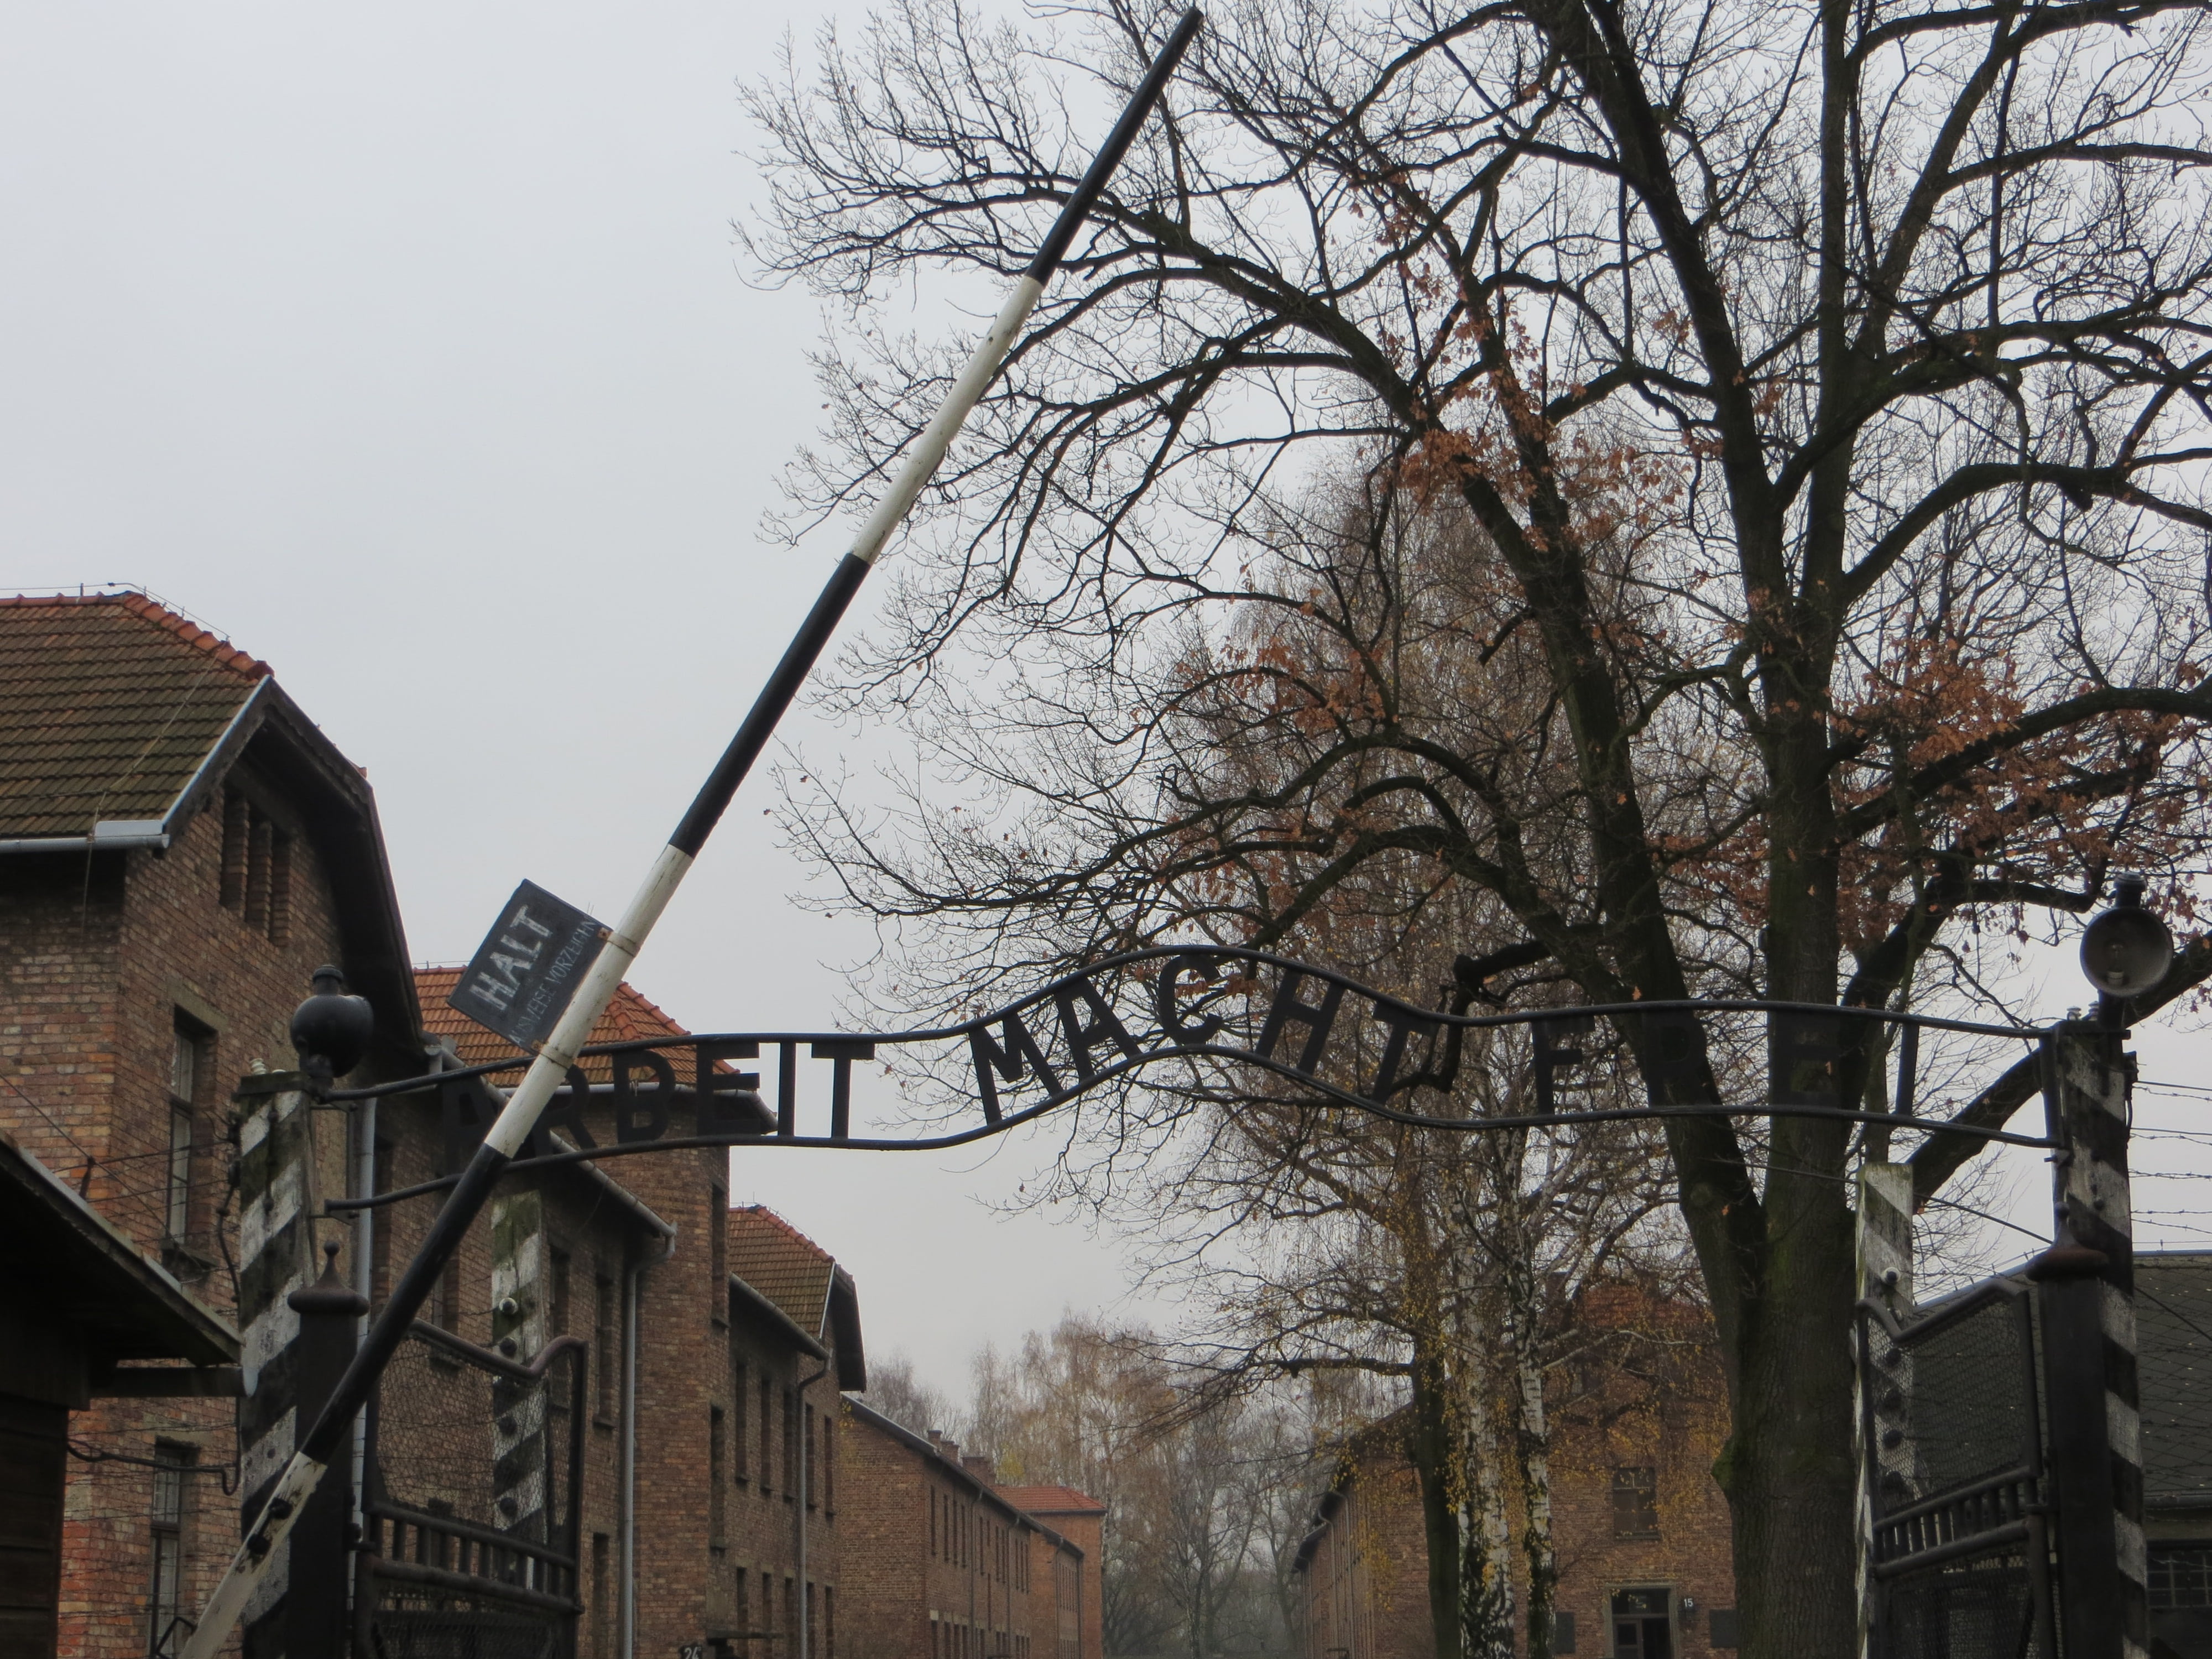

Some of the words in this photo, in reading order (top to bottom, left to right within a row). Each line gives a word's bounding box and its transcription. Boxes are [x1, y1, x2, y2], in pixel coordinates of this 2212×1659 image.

[469, 904, 553, 1011] HALT
[544, 917, 597, 985] VORZEIGEN
[441, 1042, 875, 1175] ARBEIT
[968, 952, 1436, 1125] MACHT
[1532, 1010, 1919, 1117] FREI
[1683, 1598, 1693, 1608] 15
